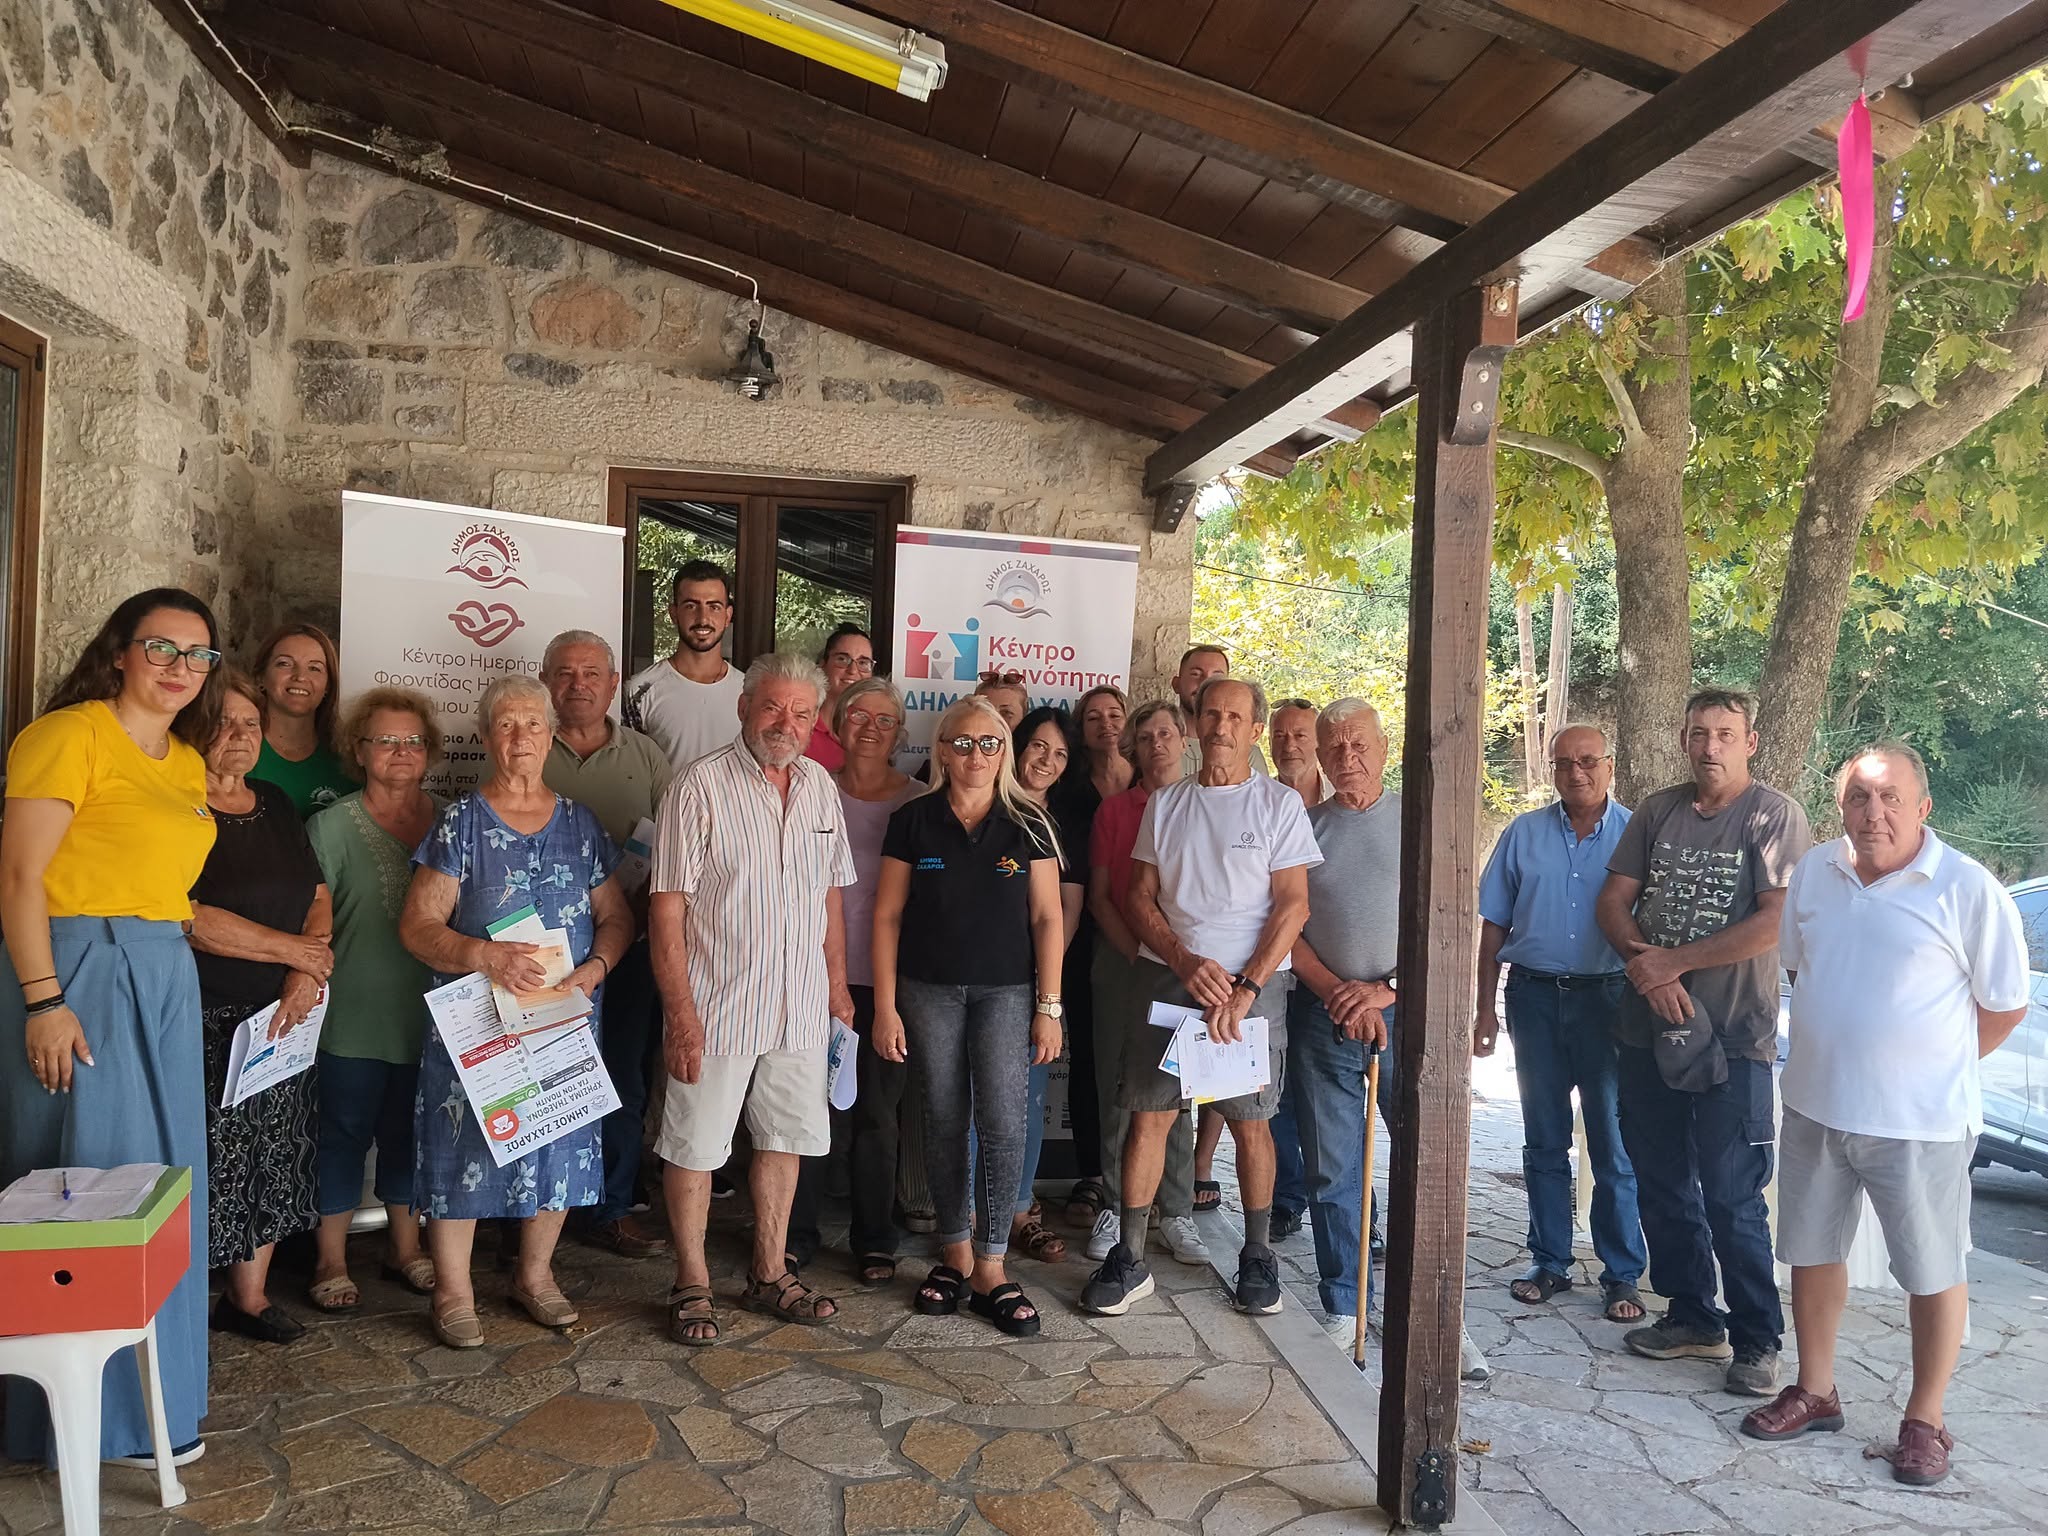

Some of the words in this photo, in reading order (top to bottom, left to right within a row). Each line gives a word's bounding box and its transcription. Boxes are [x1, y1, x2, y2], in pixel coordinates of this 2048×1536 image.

[451, 524, 480, 555] ΔΗΜΟΣ
[483, 523, 520, 563] ΖΑΧΑΡΩΣ
[985, 560, 1013, 591] ΔΗΜΟΣ
[1015, 559, 1051, 595] ΖΑΧΑΡΩΣ
[402, 648, 466, 669] Κέντρο
[470, 653, 543, 675] Ημερήσι
[988, 635, 1076, 666] Κέντρο
[374, 670, 472, 694] Φροντίδας
[986, 661, 1121, 692] Κινότητας
[435, 699, 469, 716] μου
[904, 690, 958, 713] ΔΗΜ
[443, 735, 464, 746] ριο
[902, 743, 931, 755] Δευτ
[443, 751, 487, 763] αρασκ
[568, 1080, 603, 1102] ΧΡΗΣΙΜΑ
[525, 1097, 569, 1123] ΤΗΛΕΦΩΝΑ
[554, 1105, 590, 1130] ΔΗΜΟΣ
[504, 1124, 553, 1153] ΖΑΧΑΡΩΣ
